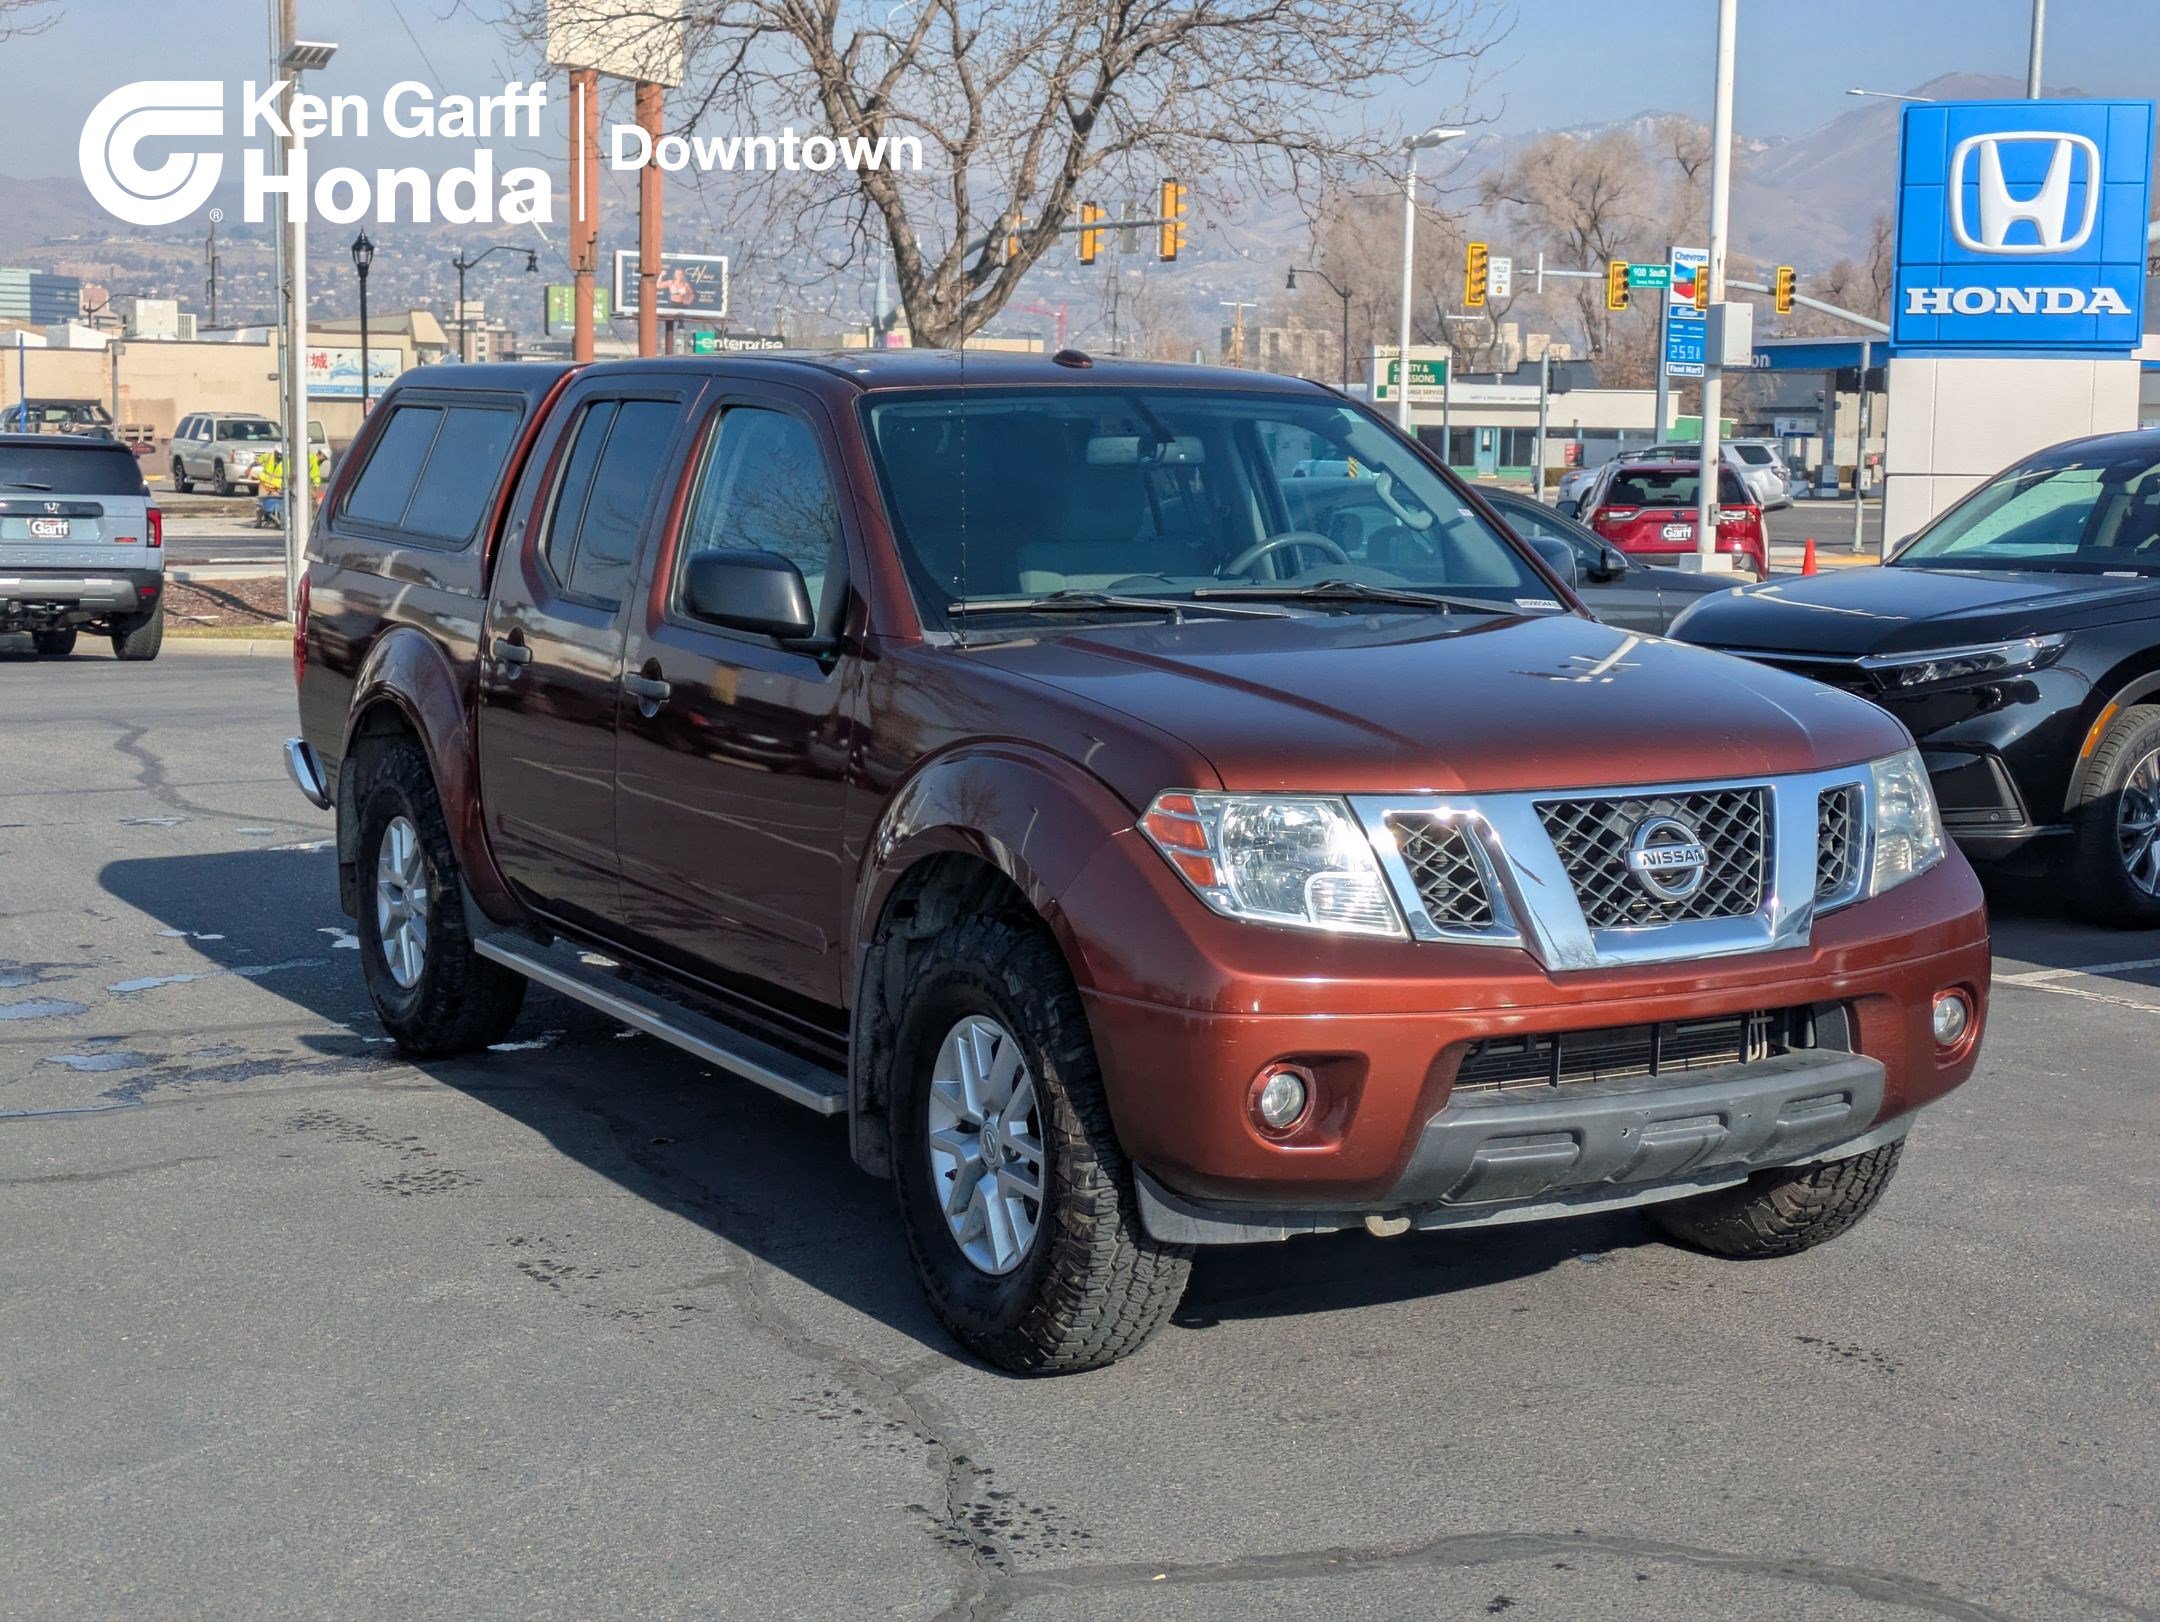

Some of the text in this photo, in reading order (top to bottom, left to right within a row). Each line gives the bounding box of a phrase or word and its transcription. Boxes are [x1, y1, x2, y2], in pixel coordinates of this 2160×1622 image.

[1674, 251, 1707, 262] Chevron
[1904, 287, 2132, 315] HONDA
[699, 336, 785, 351] enterprise
[31, 520, 69, 535] Garff
[1663, 527, 1692, 537] Garff
[1642, 848, 1705, 866] NISSAN
